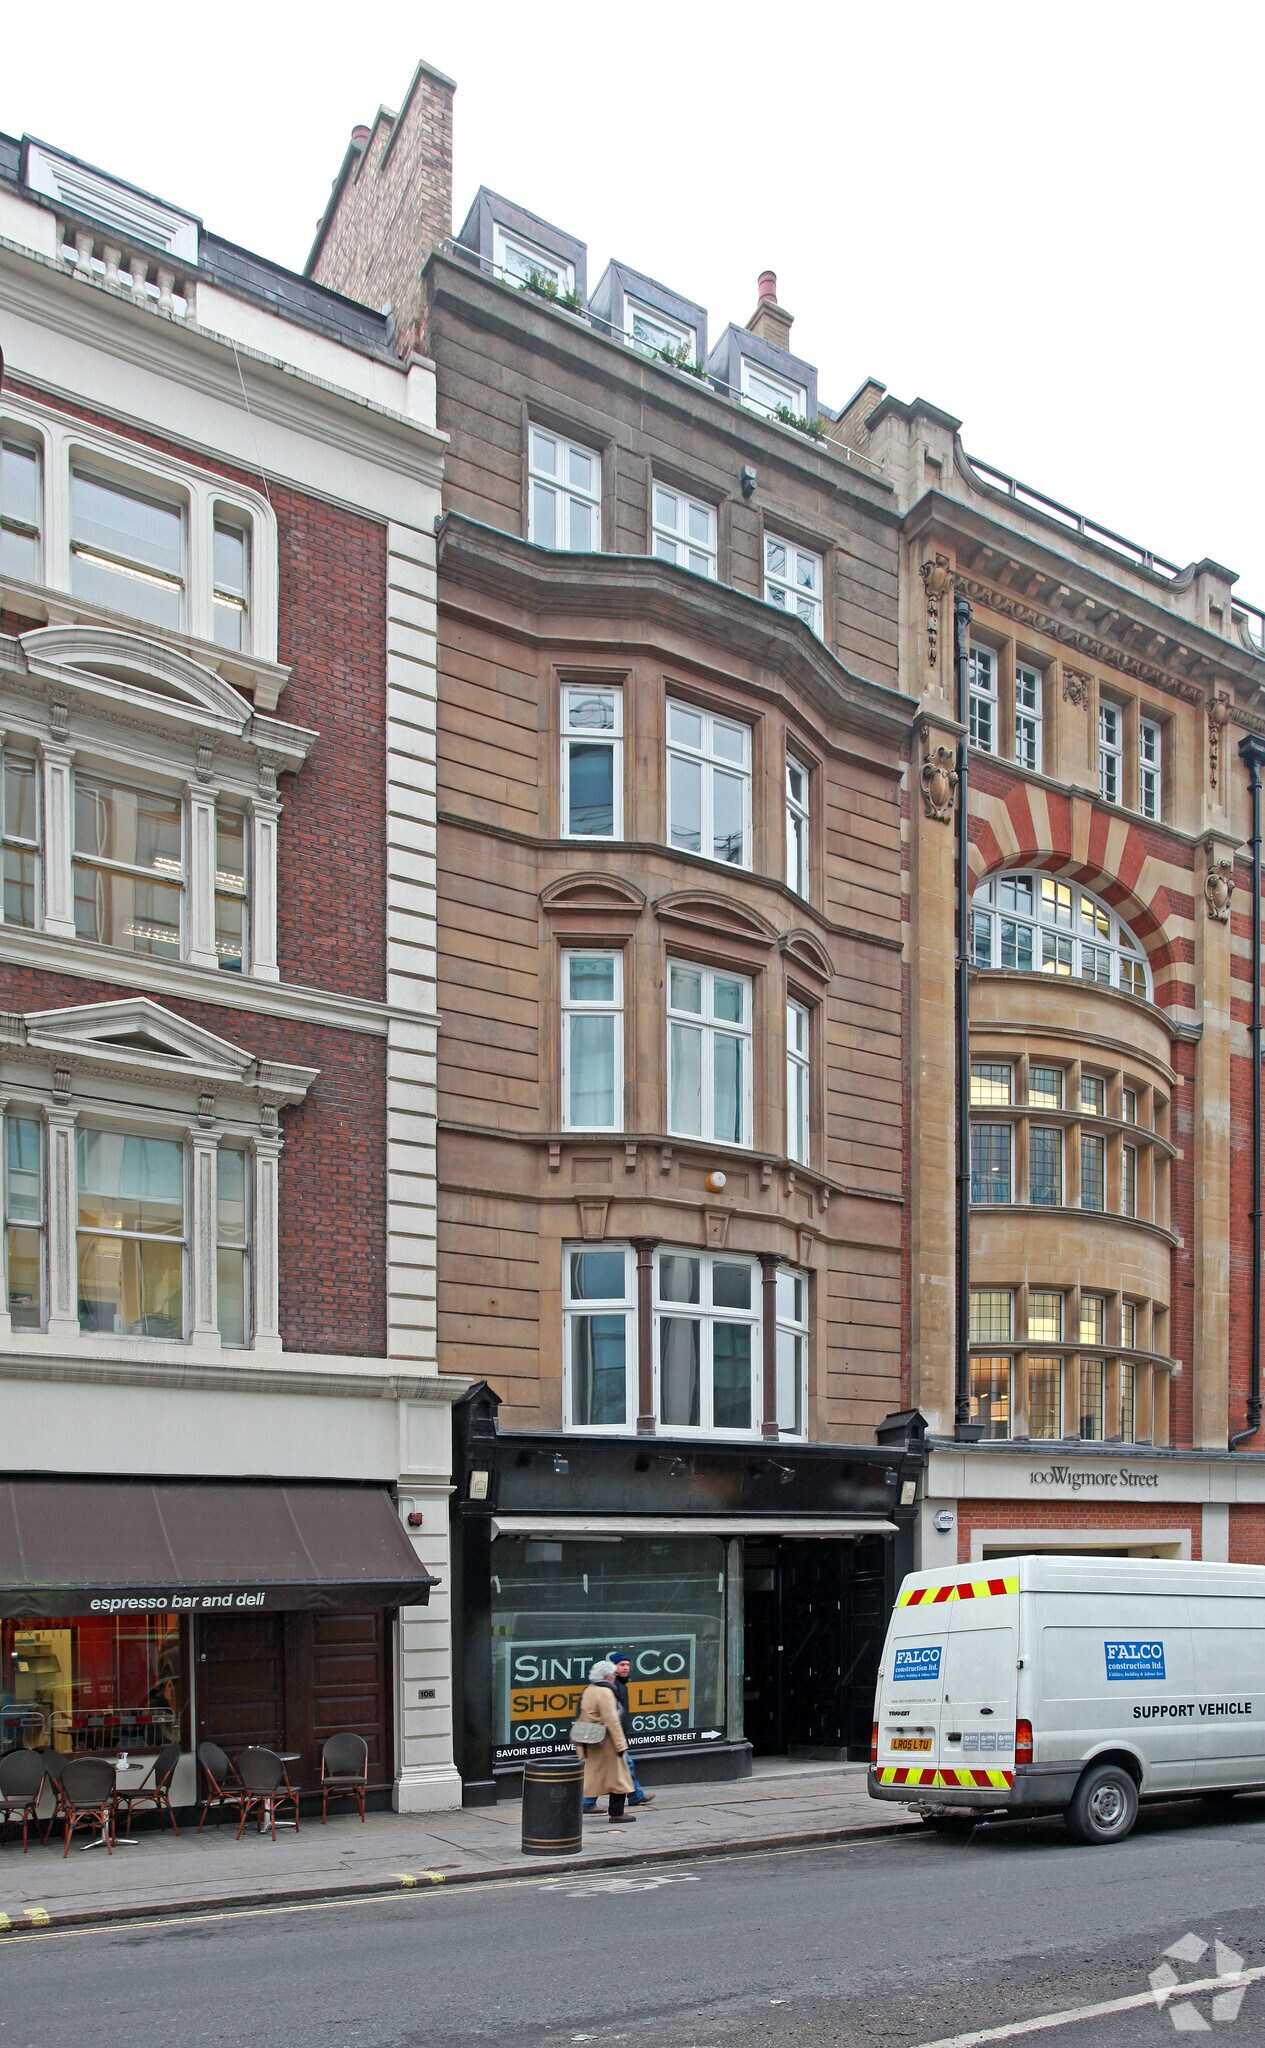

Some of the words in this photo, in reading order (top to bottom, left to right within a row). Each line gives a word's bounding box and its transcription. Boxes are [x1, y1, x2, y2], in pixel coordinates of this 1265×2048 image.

[1120, 1468, 1159, 1487] Street
[90, 1598, 168, 1613] espresso
[171, 1595, 199, 1608] bar
[202, 1593, 233, 1607] and
[236, 1592, 265, 1606] deli
[896, 1649, 940, 1665] FALCO
[1106, 1644, 1162, 1660] FALCO
[1108, 1662, 1151, 1670] construction
[420, 1690, 434, 1698] 106
[638, 1686, 687, 1706] LET
[1133, 1704, 1195, 1718] SUPPORT
[1198, 1702, 1252, 1715] VEHICLE
[515, 1723, 557, 1741] 020
[631, 1713, 682, 1732] 6363
[496, 1747, 528, 1758] SAVOIR
[529, 1745, 553, 1755] BEDS
[554, 1743, 577, 1752] HAVE
[627, 1737, 666, 1745] WIGMORE
[667, 1732, 697, 1741] STREET
[913, 1740, 929, 1750] LTU
